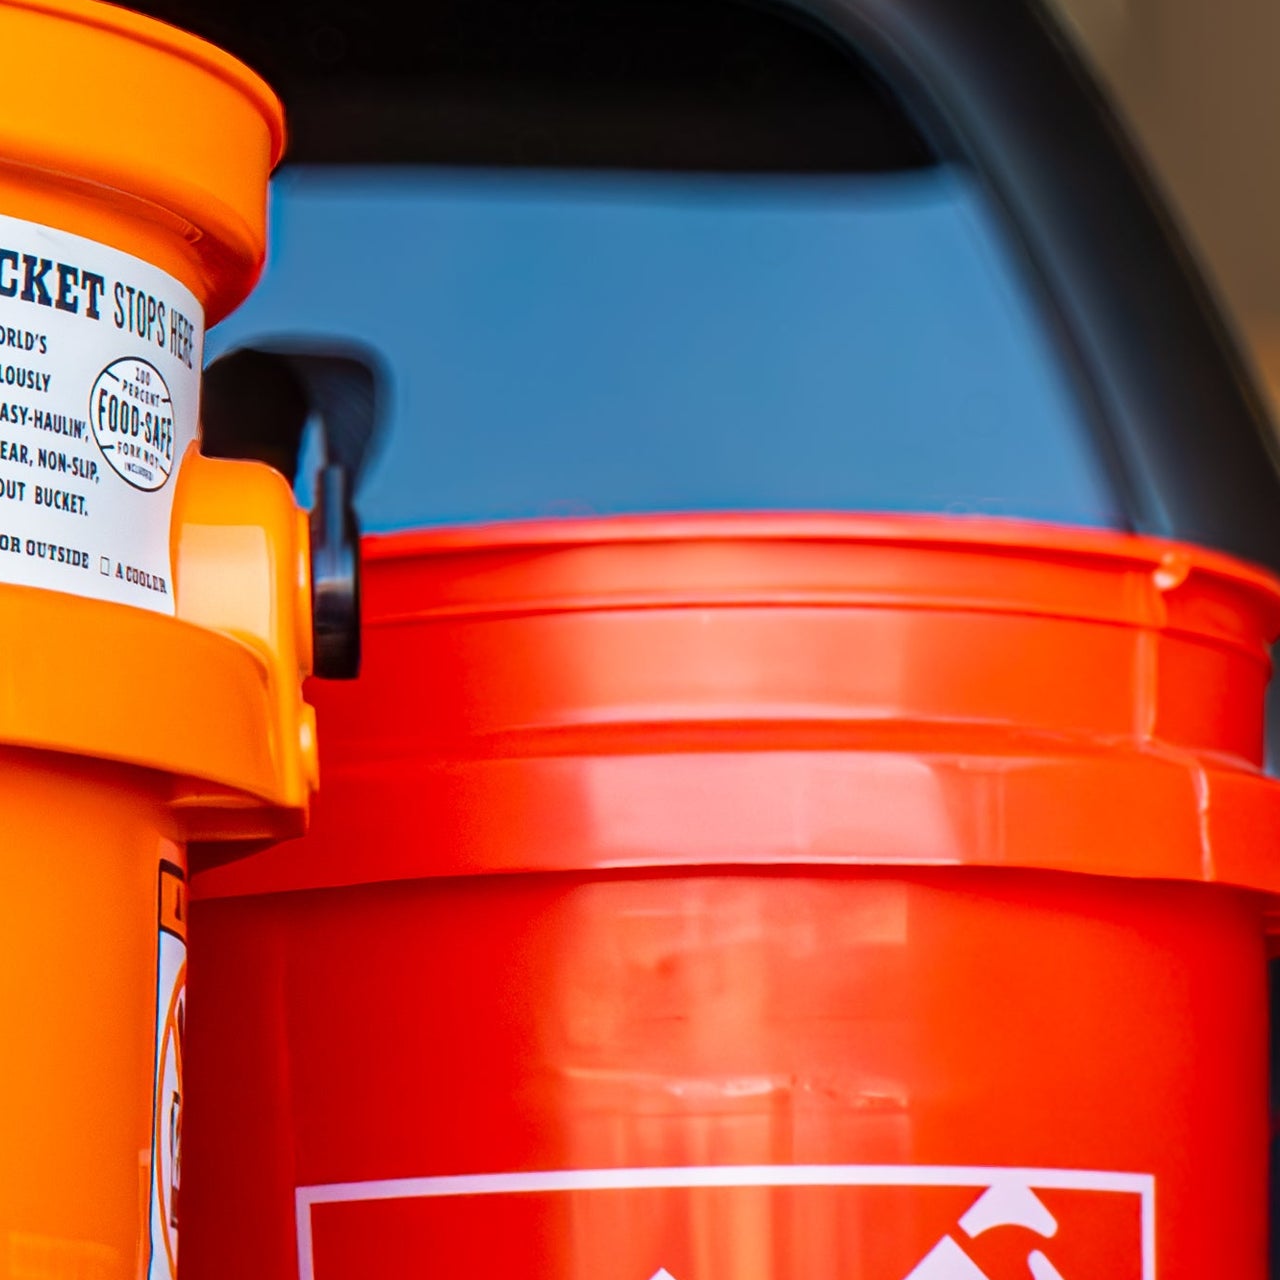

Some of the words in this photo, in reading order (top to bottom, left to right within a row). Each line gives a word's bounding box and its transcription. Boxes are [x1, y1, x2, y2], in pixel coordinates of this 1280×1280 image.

[114, 282, 165, 348] STOPS
[122, 379, 160, 407] PERCENT
[99, 388, 172, 460] FOOD-SAFE
[38, 448, 100, 483] NON-SLIP,
[117, 441, 140, 458] FORK
[35, 486, 88, 517] BUCKET.
[26, 539, 89, 570] OUTSIDE
[115, 562, 124, 579] A
[126, 565, 167, 594] COOLER
